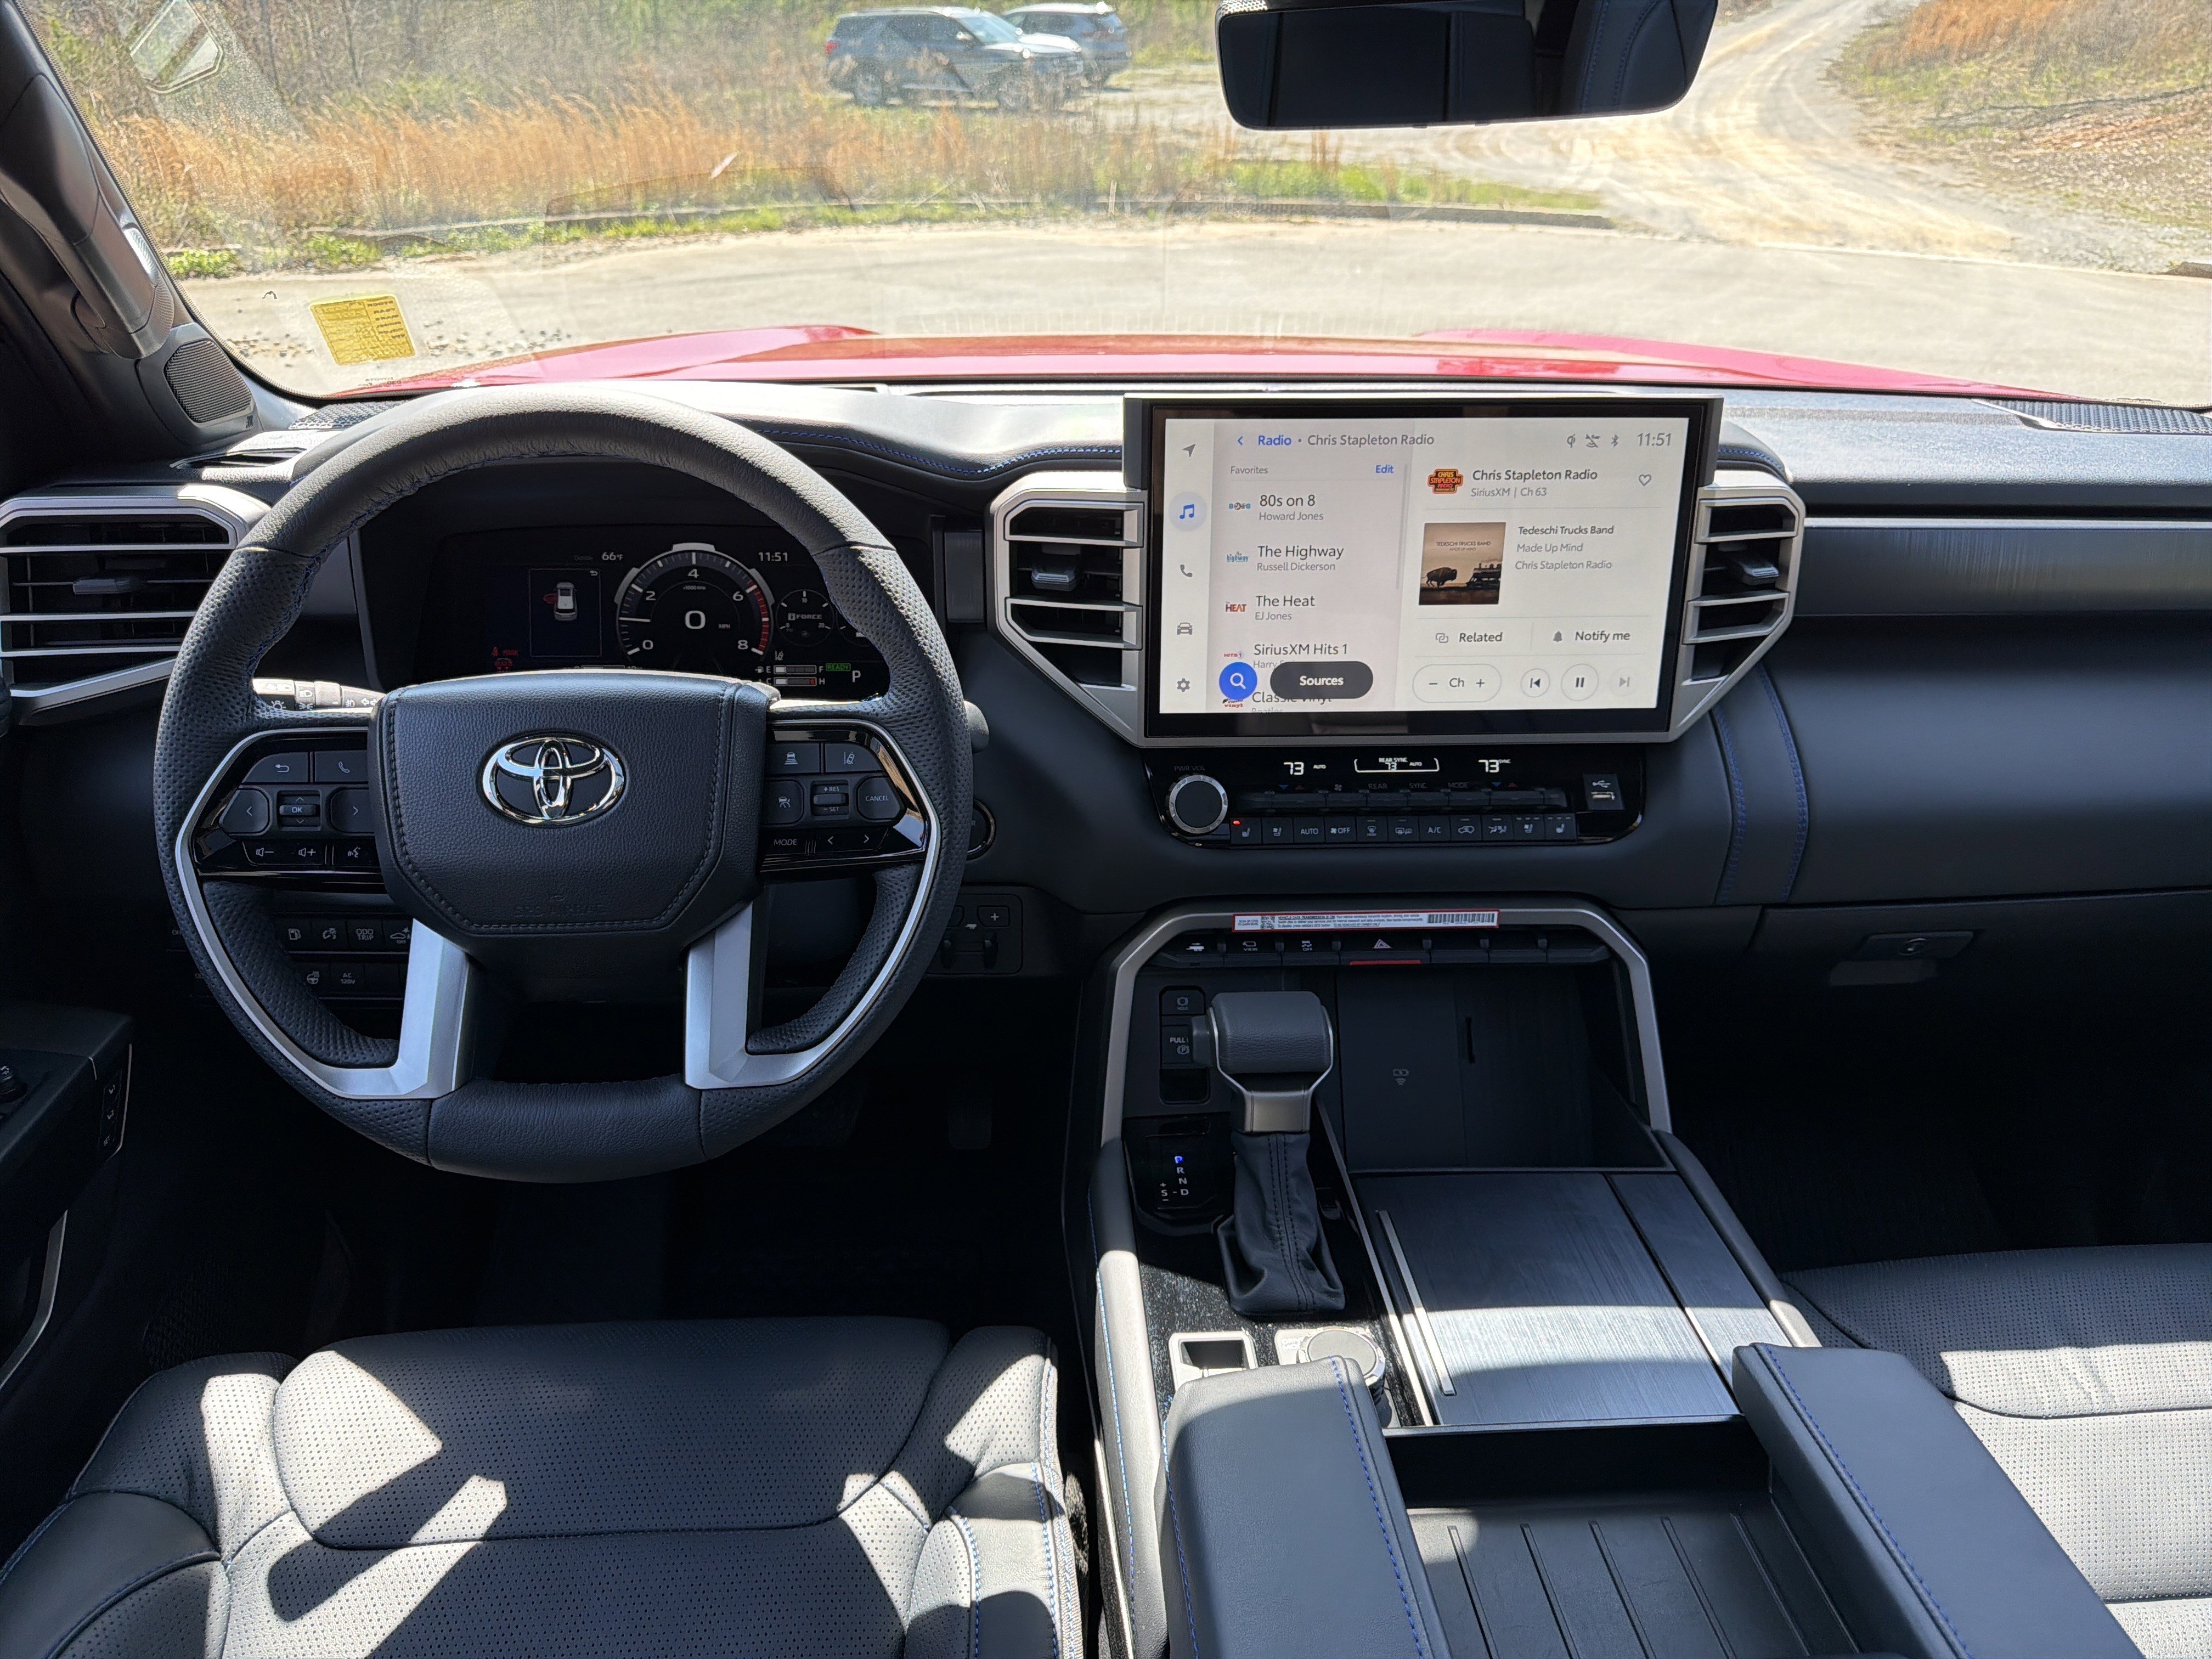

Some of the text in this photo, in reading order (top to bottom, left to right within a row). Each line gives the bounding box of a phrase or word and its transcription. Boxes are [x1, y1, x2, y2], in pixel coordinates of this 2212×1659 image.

[1258, 434, 1434, 448] Radio Chris Stapleton Radio
[1637, 433, 1672, 446] 11:51
[1231, 465, 1268, 475] Favorites
[1375, 465, 1394, 473] Edit
[1472, 469, 1598, 483] Chris Stapleton Radio
[1471, 488, 1510, 497] SiriusXM
[1520, 488, 1533, 496] Ch
[1535, 488, 1547, 496] 63
[1260, 494, 1283, 506] 80s
[1286, 498, 1304, 506] on
[1308, 494, 1316, 506] 8
[1259, 511, 1323, 521] Howard Jones
[1518, 525, 1615, 535] Tedeschi Trucks Band
[1257, 545, 1344, 560] The Highway
[1516, 543, 1583, 554] Made Up Mind
[759, 552, 788, 561] 11:51
[1227, 554, 1249, 562] highway
[1257, 562, 1335, 571] Russell Dickerson
[1515, 561, 1612, 571] Chris Stapleton Radio
[688, 569, 699, 578] 4
[646, 591, 656, 601] 2
[732, 591, 743, 601] 6
[1255, 595, 1315, 606] The Heat
[685, 611, 706, 629] 0
[1255, 612, 1264, 620] EJ
[1459, 632, 1503, 642] Related
[1575, 631, 1610, 643] Notify
[642, 640, 653, 650] 0
[737, 640, 748, 650] 8
[1254, 644, 1347, 656] SiriusXM Hits 1
[1254, 661, 1277, 669] Harry
[852, 670, 861, 682] P
[1299, 675, 1344, 686] Sources
[1449, 678, 1465, 687] Ch
[1284, 762, 1304, 775] 73
[1479, 760, 1499, 772] 73
[1175, 1155, 1183, 1164] P
